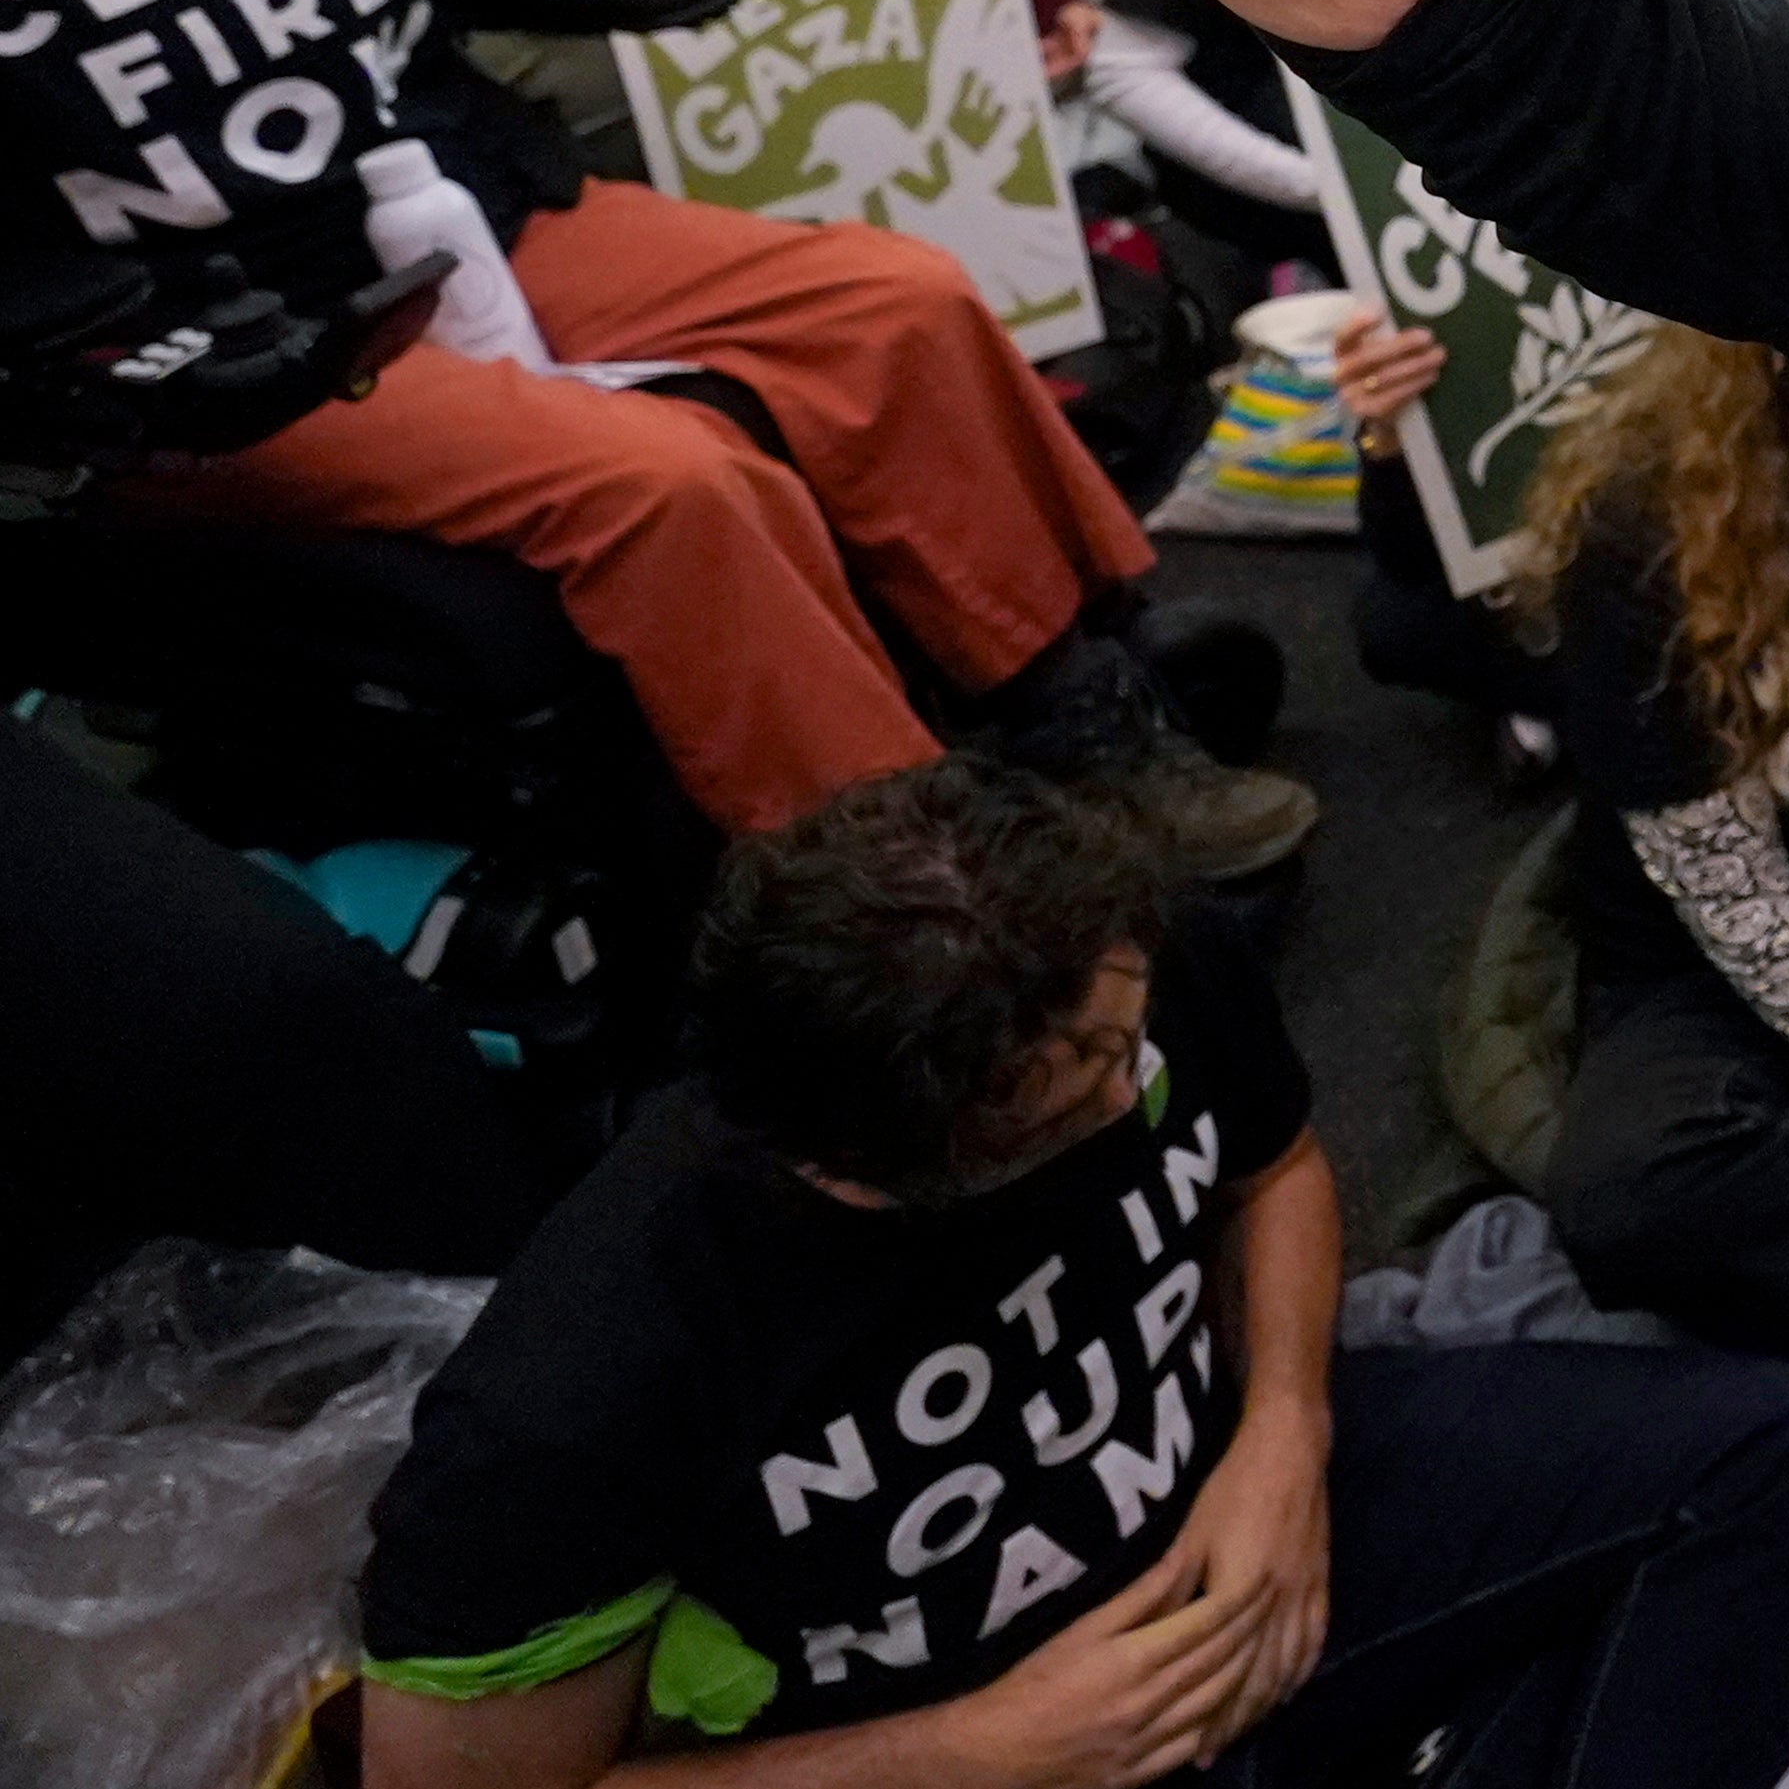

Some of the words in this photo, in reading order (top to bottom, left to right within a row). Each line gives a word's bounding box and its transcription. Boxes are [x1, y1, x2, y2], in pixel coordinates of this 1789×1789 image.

[761, 1253, 1066, 1538] NOT
[1118, 1111, 1221, 1265] IN
[803, 1322, 1212, 1685] NAM
